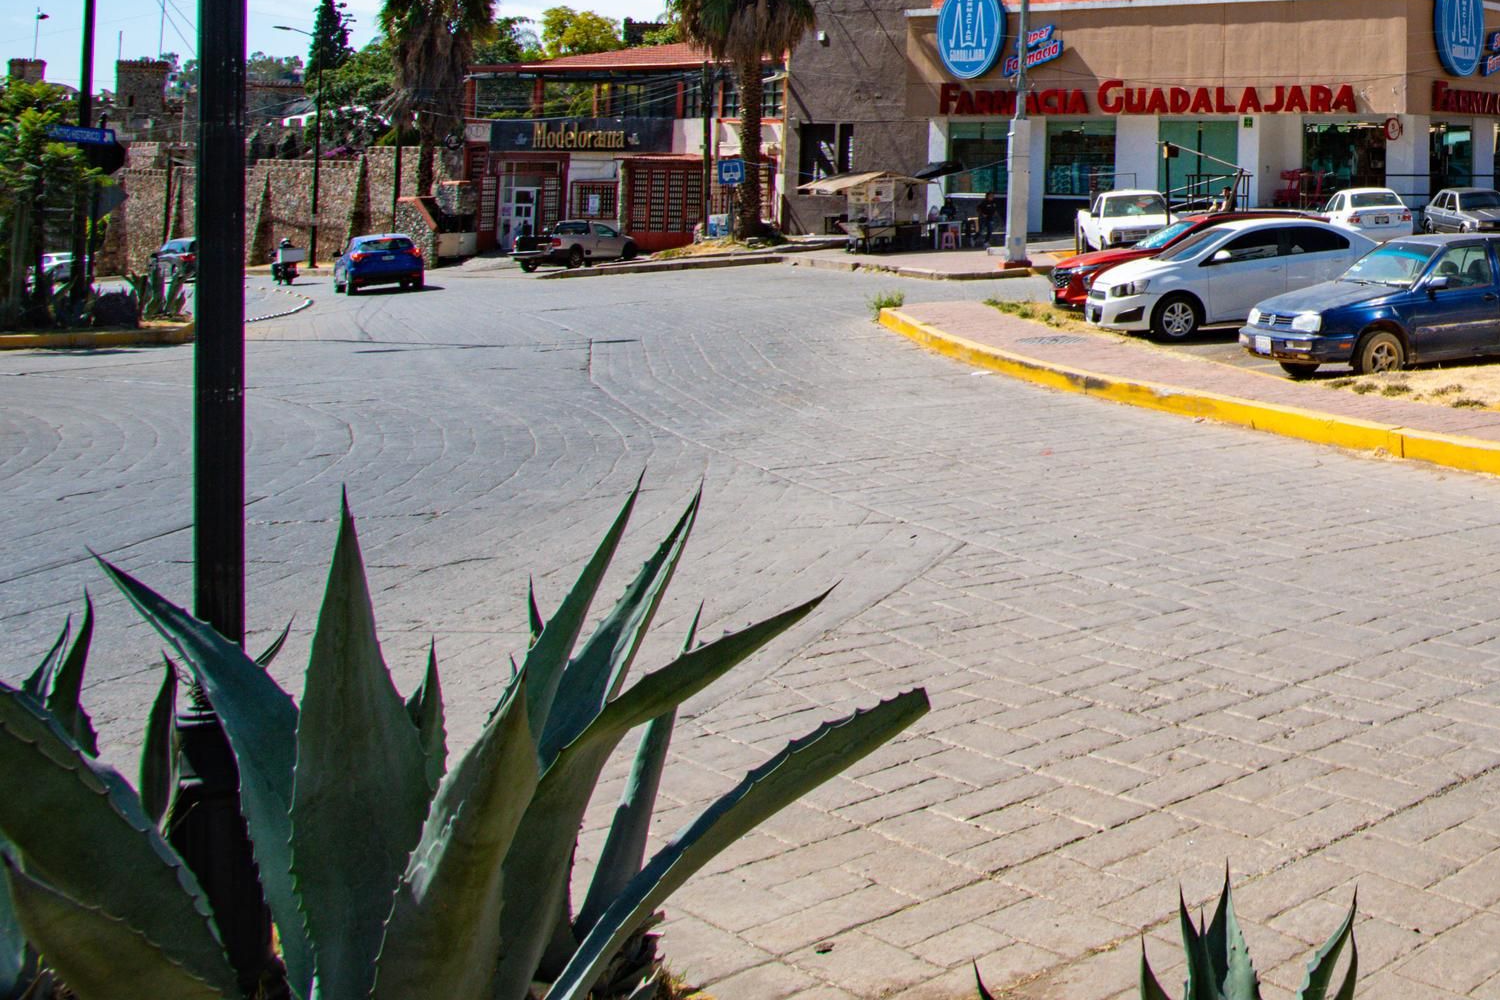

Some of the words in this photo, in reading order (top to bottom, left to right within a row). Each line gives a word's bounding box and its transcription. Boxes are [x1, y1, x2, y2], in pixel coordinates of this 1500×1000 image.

[1005, 41, 1059, 73] Famacia
[1098, 80, 1359, 114] GUADALAJARA
[532, 121, 625, 149] Modelorama
